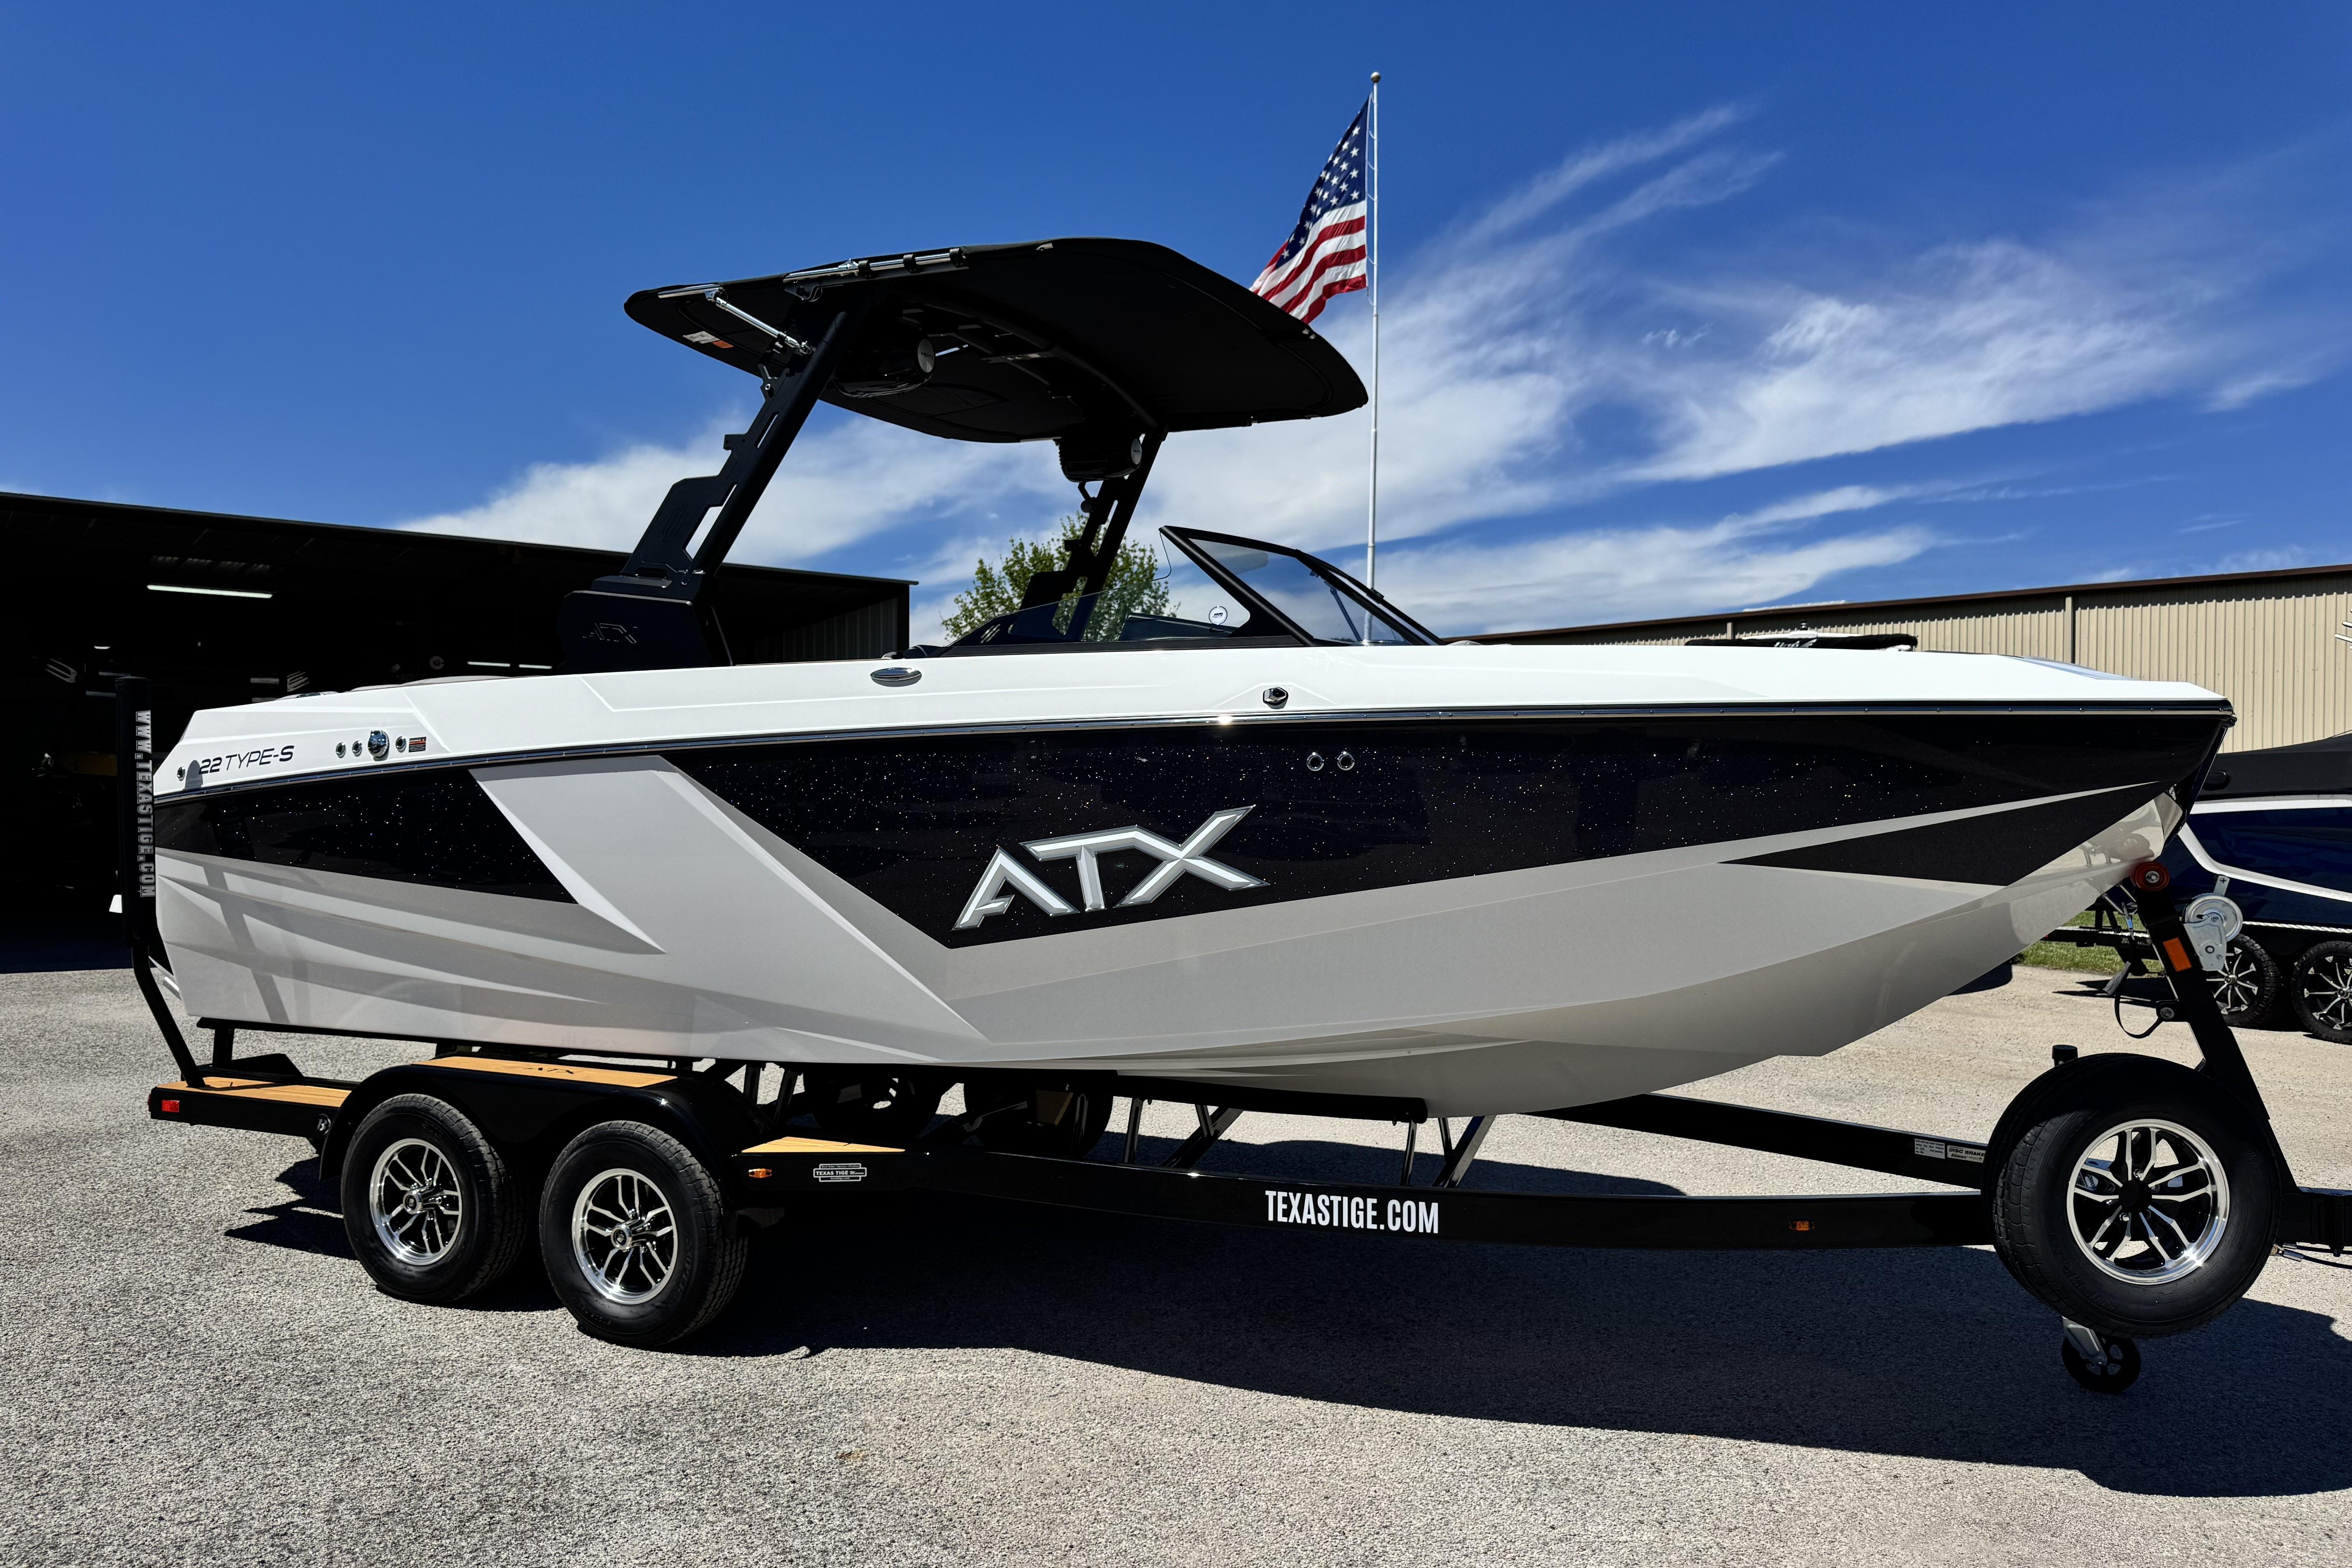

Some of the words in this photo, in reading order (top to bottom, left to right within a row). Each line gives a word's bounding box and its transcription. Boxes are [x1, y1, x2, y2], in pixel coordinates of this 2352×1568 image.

[198, 757, 222, 775] 22
[225, 745, 295, 770] TYPE-S
[135, 710, 156, 897] WWW.TEXASTIGE.COM
[950, 804, 1271, 931] ATX
[1265, 1190, 1439, 1234] TEXASTIGE.COM
